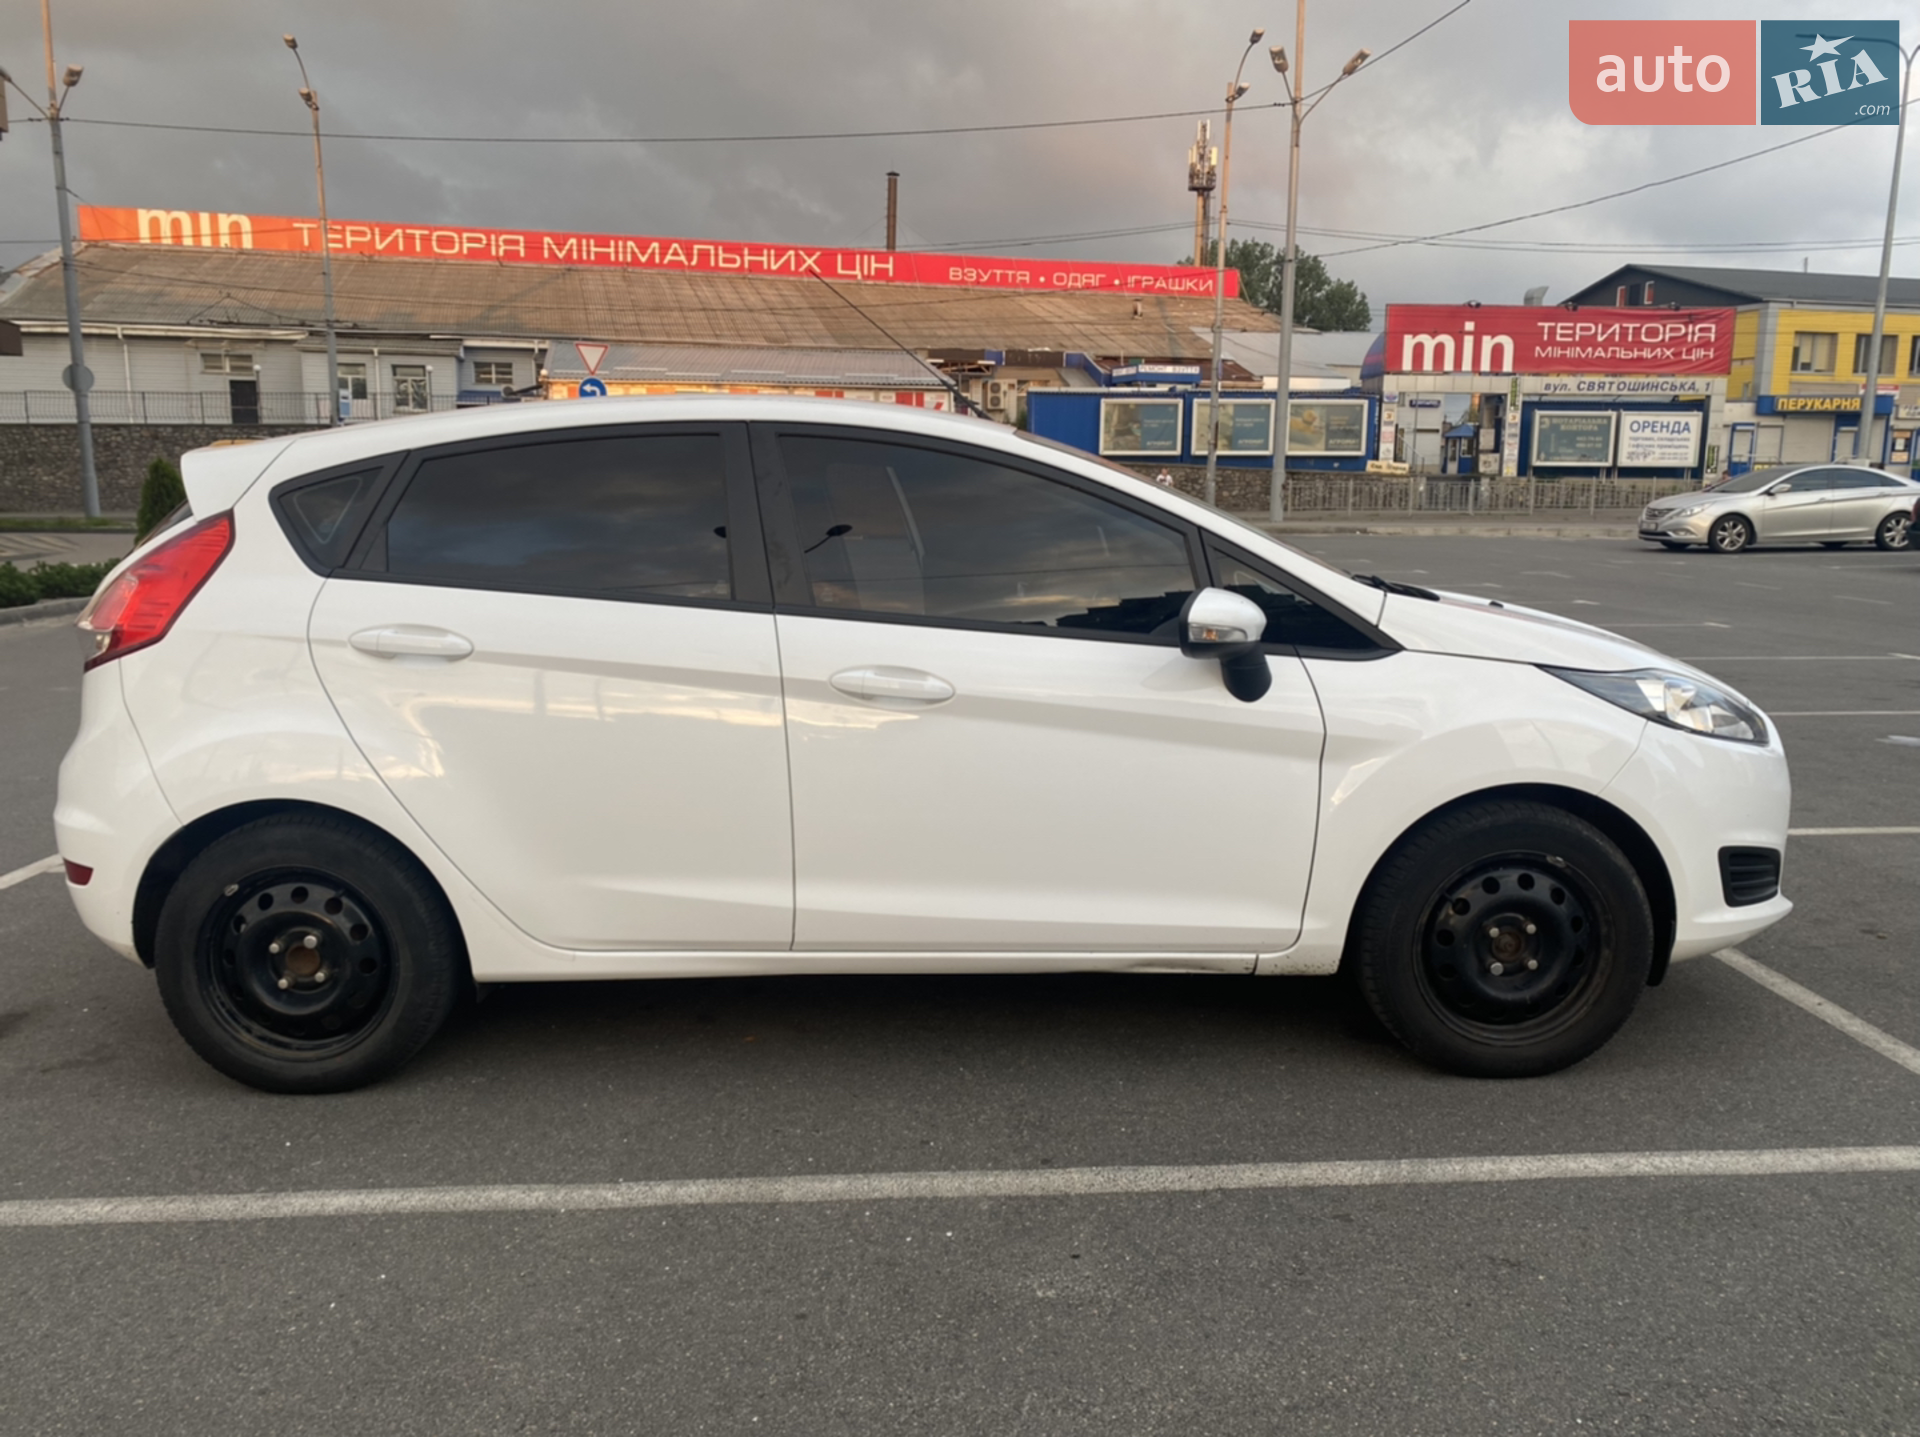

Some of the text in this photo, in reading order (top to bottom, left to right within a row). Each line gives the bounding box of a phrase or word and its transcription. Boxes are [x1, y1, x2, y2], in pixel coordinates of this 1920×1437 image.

[137, 208, 253, 249] min
[292, 222, 894, 280] ТЕРИТОРІЯ МІНІМАЛЬНИХ ЦІН
[949, 266, 1214, 292] ВЗУТТЯ ОДЯГ ІГРАШКИ
[1537, 321, 1716, 343] ТЕРИТОРІЯ
[1401, 320, 1515, 373] min
[1534, 345, 1715, 362] МІНІМАЛЬНИХ ЦІН
[1543, 379, 1712, 394] вул. СВЯТОШИНСЬКА, 1
[1777, 397, 1862, 410] ПЕРУКАРНЯ
[1629, 420, 1692, 434] ОРЕНДА
